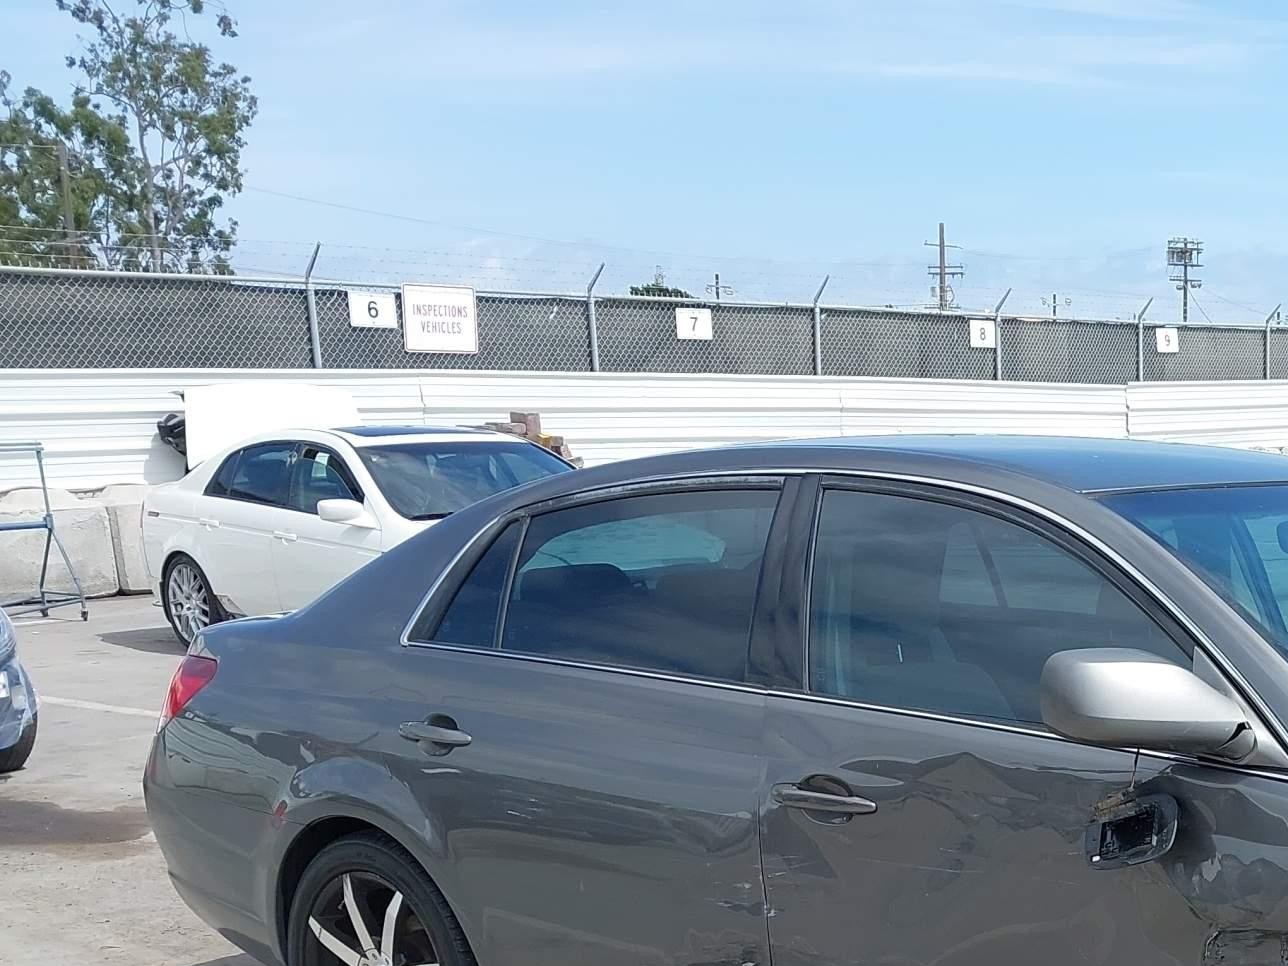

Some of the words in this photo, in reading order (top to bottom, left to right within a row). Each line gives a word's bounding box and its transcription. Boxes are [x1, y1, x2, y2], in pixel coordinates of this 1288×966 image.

[367, 301, 379, 318] 6
[412, 304, 468, 318] INSPECTIONS
[421, 321, 462, 334] VEHICLES
[690, 316, 698, 331] 7
[980, 327, 986, 341] 8
[1164, 335, 1170, 347] 9
